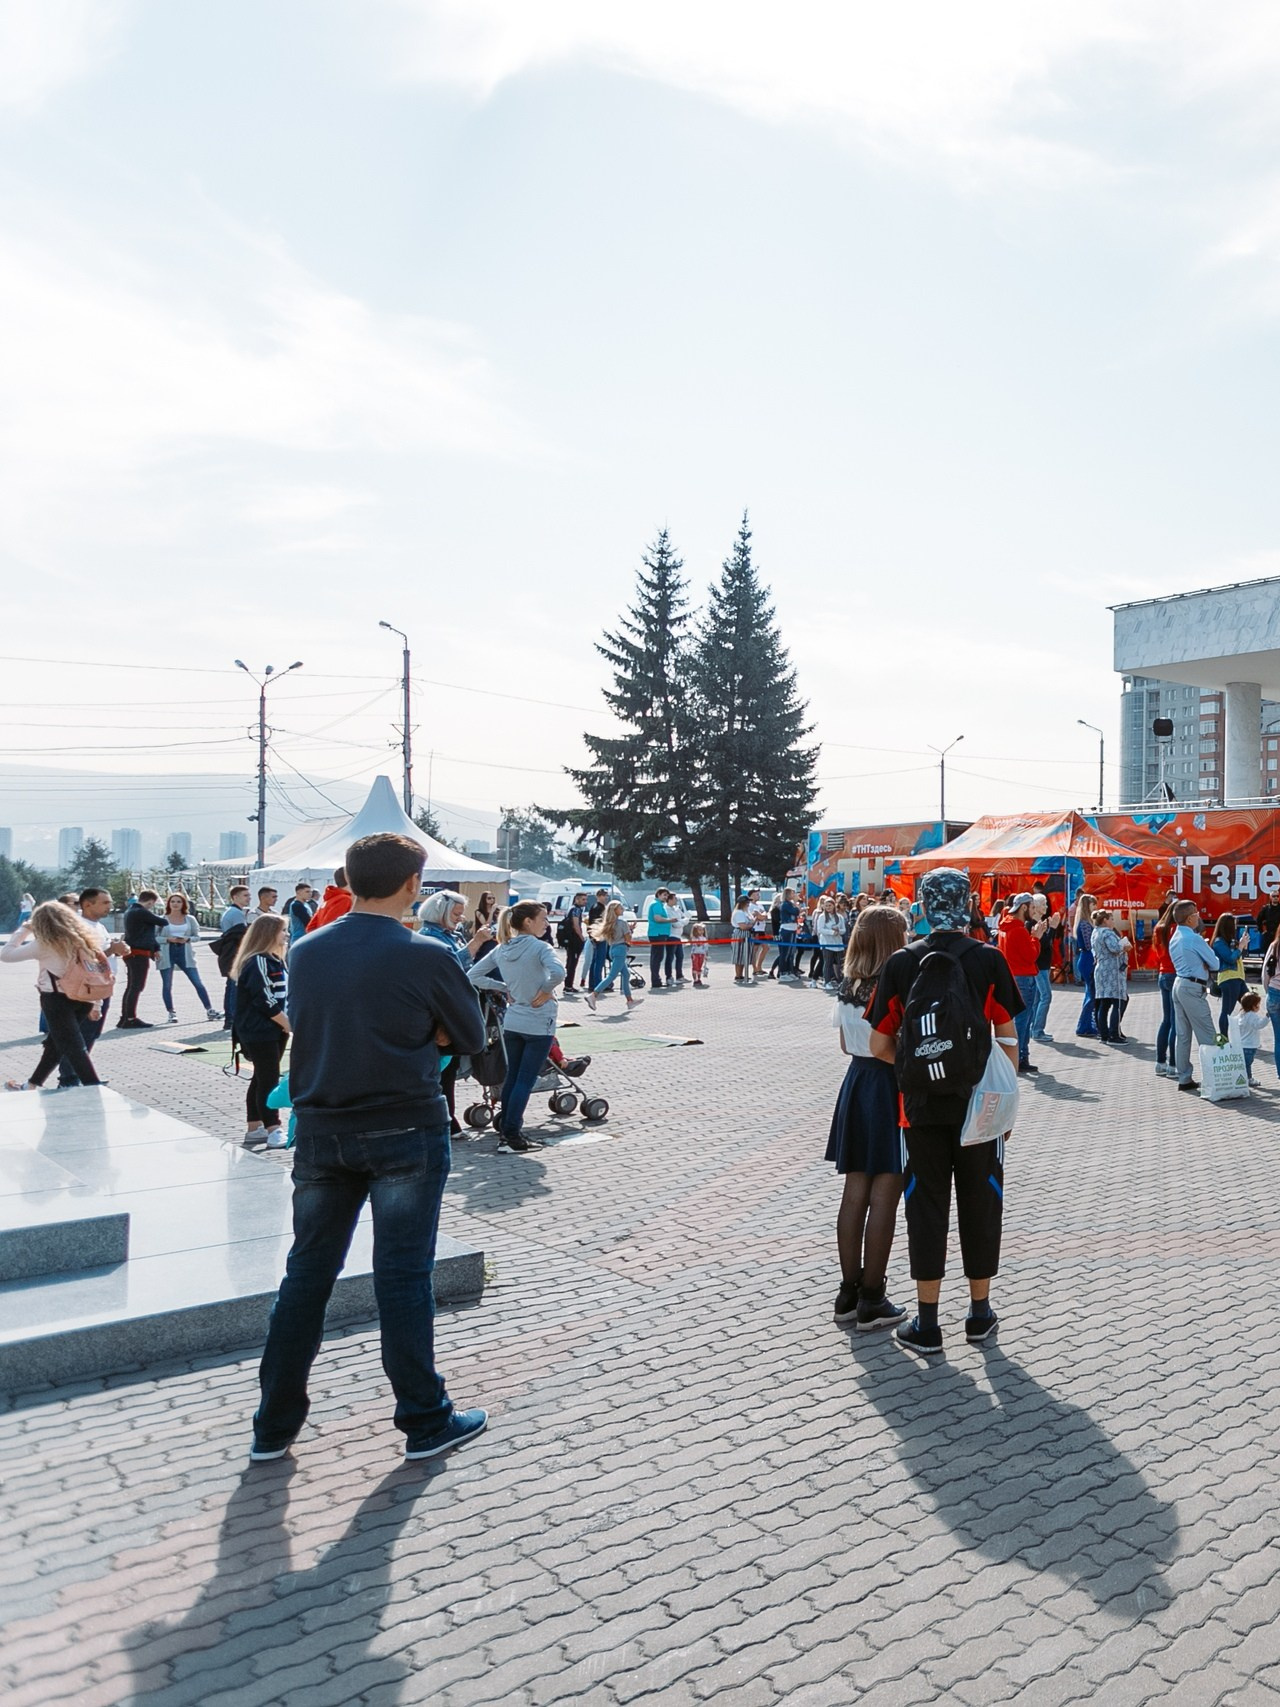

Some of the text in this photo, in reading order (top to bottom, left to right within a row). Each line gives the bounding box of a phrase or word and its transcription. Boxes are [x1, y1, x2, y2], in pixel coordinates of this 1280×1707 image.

[851, 843, 892, 855] #ТНТздесь
[836, 855, 908, 896] ТН
[914, 1039, 953, 1057] adidas
